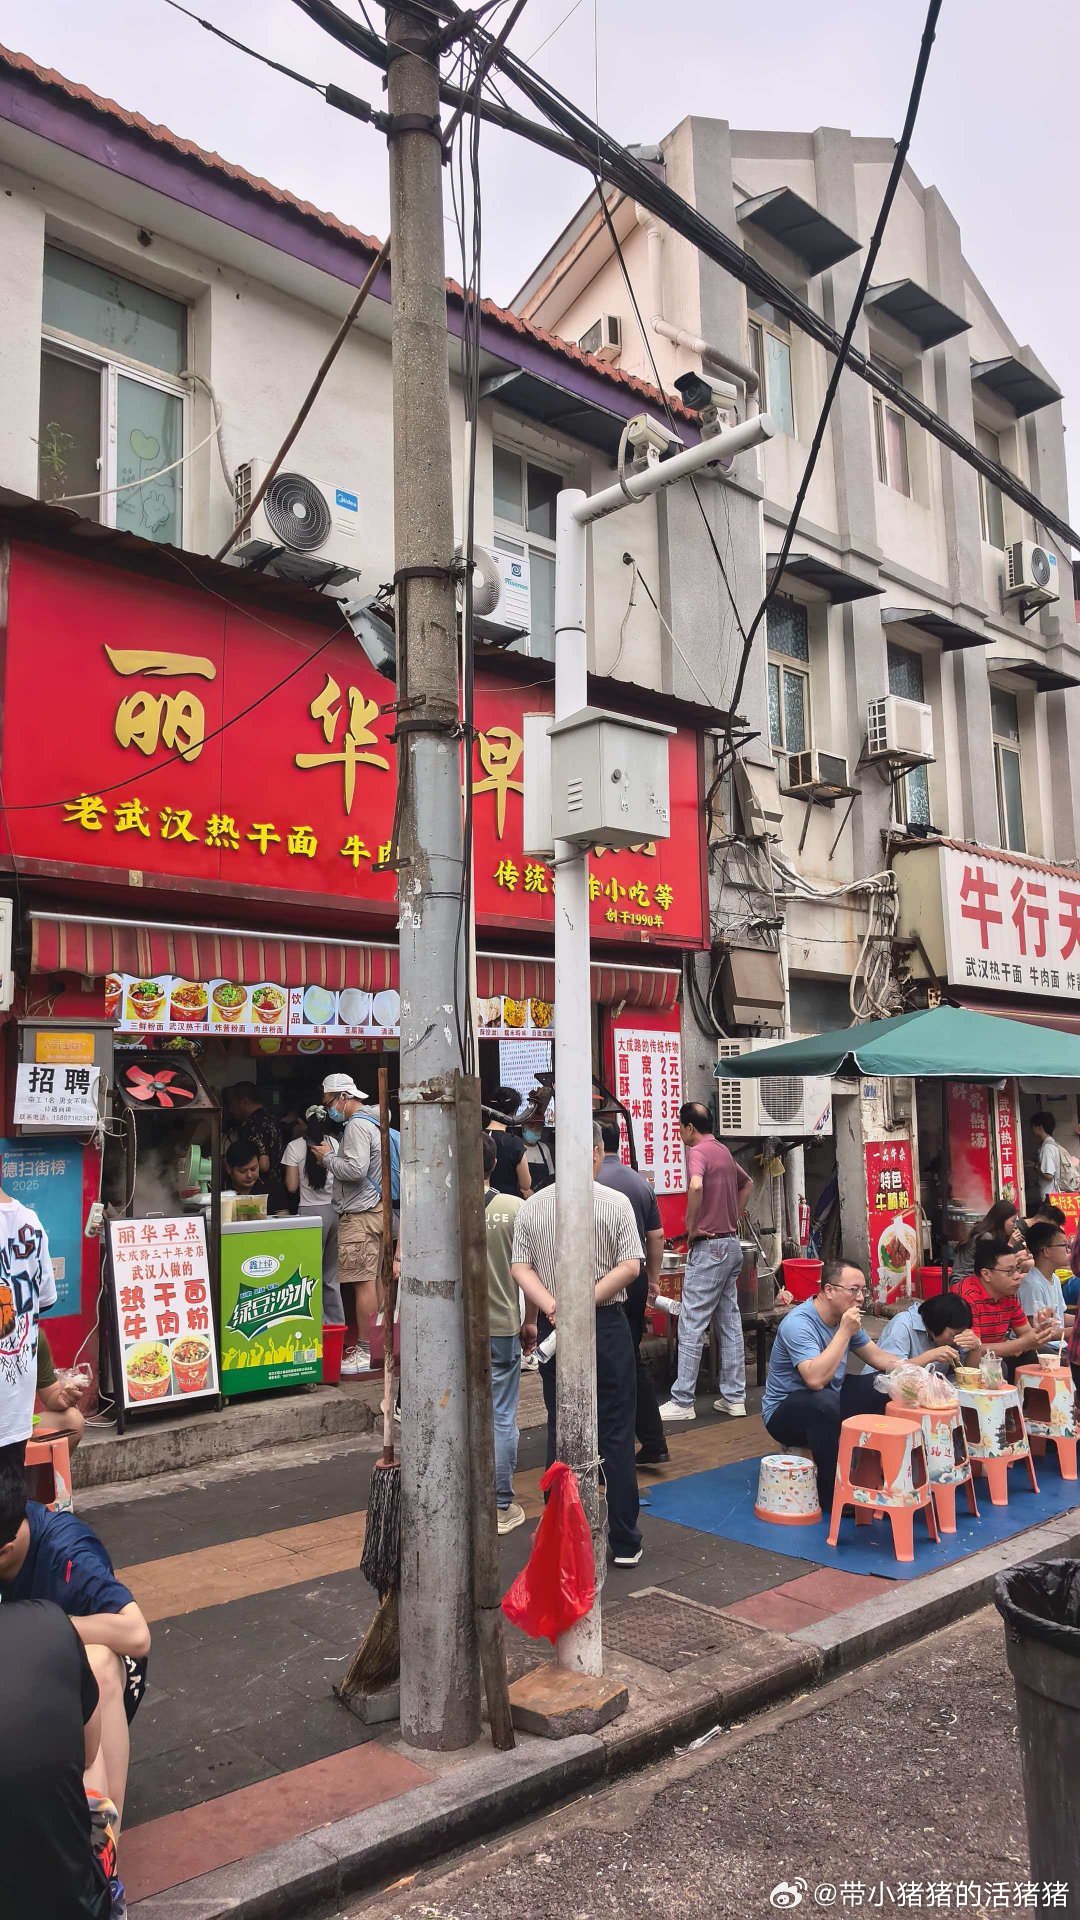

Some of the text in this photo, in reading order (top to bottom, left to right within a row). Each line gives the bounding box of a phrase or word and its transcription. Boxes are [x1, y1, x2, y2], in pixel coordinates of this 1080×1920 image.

[505, 577, 529, 590] Hisense
[62, 792, 319, 858] 老武汉热干面
[605, 907, 664, 929] 创于1990年
[965, 957, 1022, 984] 武汉热干面
[1029, 966, 1060, 989] 牛肉面
[291, 993, 301, 1024] 饮品
[169, 1022, 210, 1031] 武汉热干面
[617, 1037, 679, 1055] 大成路的传统炸物
[660, 1056, 679, 1076] 2元
[28, 1067, 91, 1095] 招聘
[661, 1078, 680, 1098] 3元
[661, 1100, 680, 1119] 3元
[662, 1122, 681, 1142] 2元
[999, 1099, 1014, 1178] 武汉热干面
[663, 1144, 682, 1163] 2元
[12, 1180, 40, 1191] 2025
[664, 1169, 683, 1188] 3元
[880, 1170, 902, 1190] 特色
[117, 1222, 200, 1244] 丽华早点
[116, 1245, 205, 1262] 大成路三十年老店
[131, 1261, 193, 1280] 武汉人做的
[119, 1278, 207, 1312] 热干面
[233, 1276, 314, 1327] 绿豆沙冰
[123, 1305, 209, 1339] 牛肉粉
